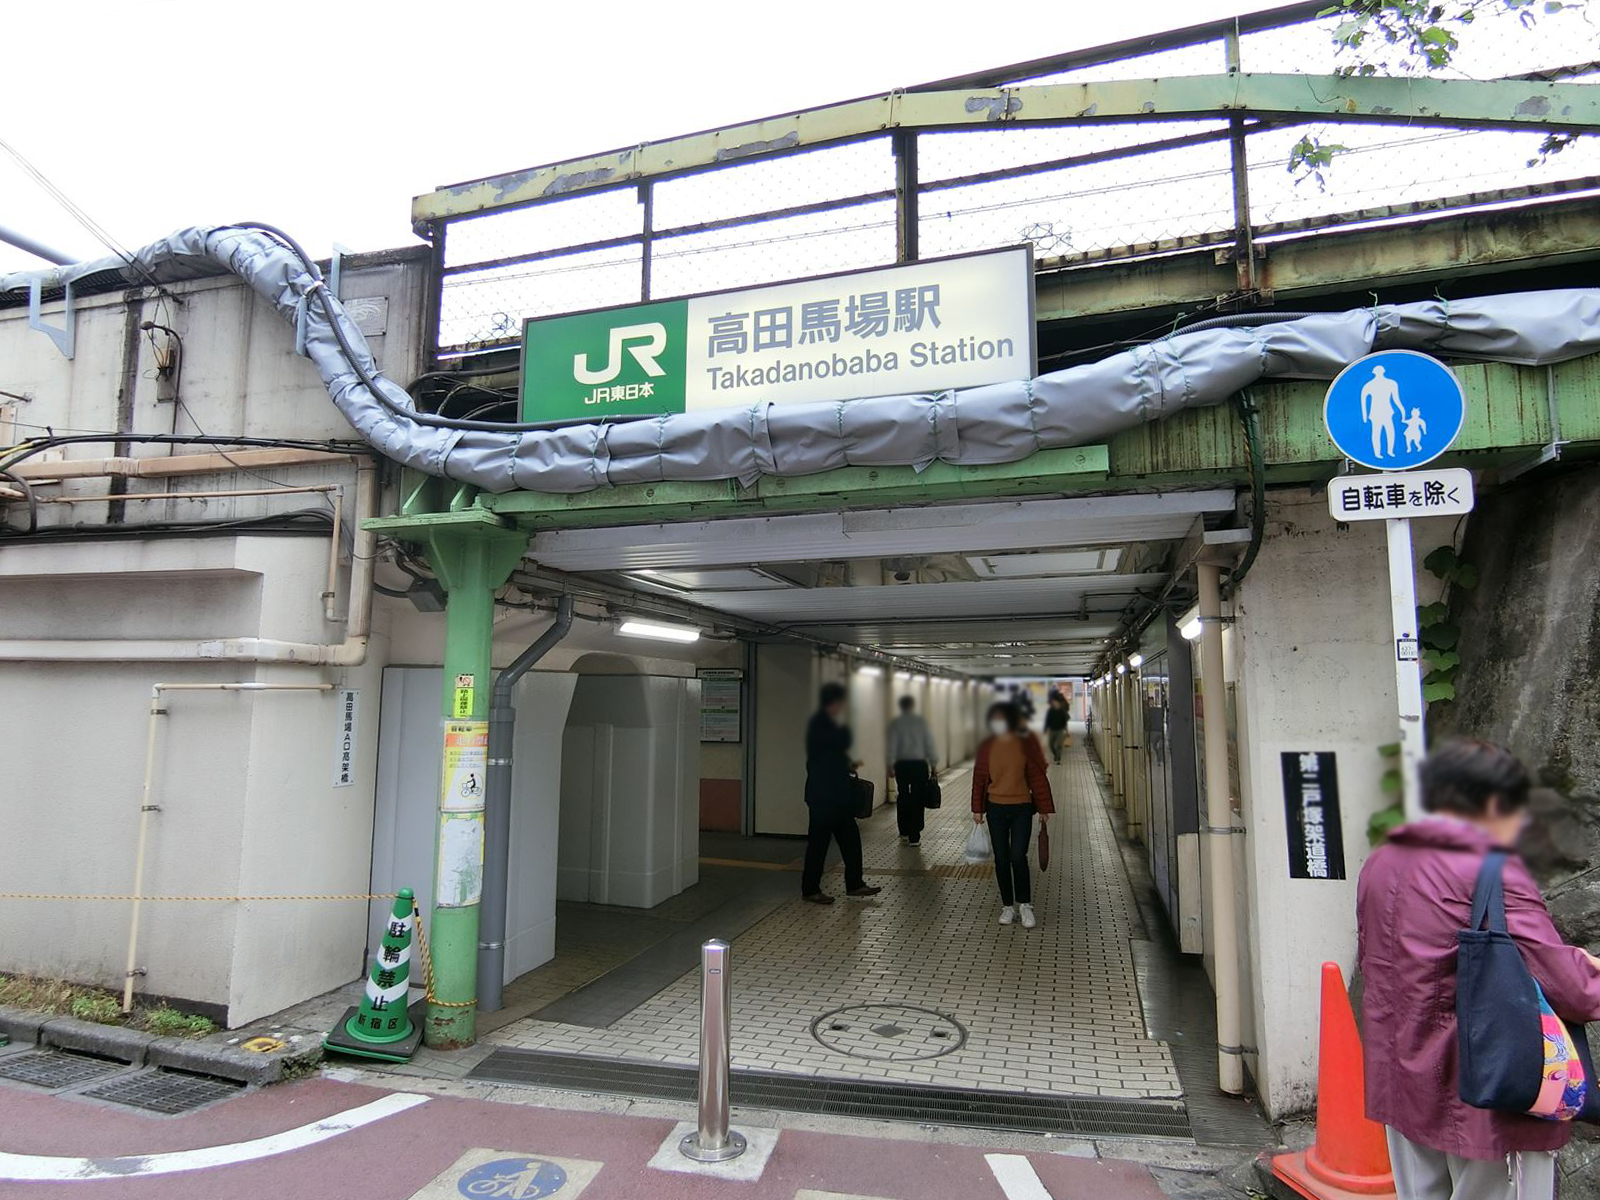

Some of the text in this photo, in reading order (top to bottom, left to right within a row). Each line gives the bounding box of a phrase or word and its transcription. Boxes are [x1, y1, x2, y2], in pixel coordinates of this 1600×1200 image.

[708, 284, 941, 358] 高田馬場駅
[573, 322, 667, 385] JR
[707, 337, 1014, 391] Takadanobaba Station
[584, 382, 654, 405] JR東日本
[1342, 480, 1460, 511] 自転車を除く
[341, 692, 354, 783] 高田馬場A口高架橋
[1299, 752, 1328, 878] 第二戸塚架道橋
[371, 921, 406, 1012] 駐輪禁止
[358, 1013, 398, 1030] 新宿区
